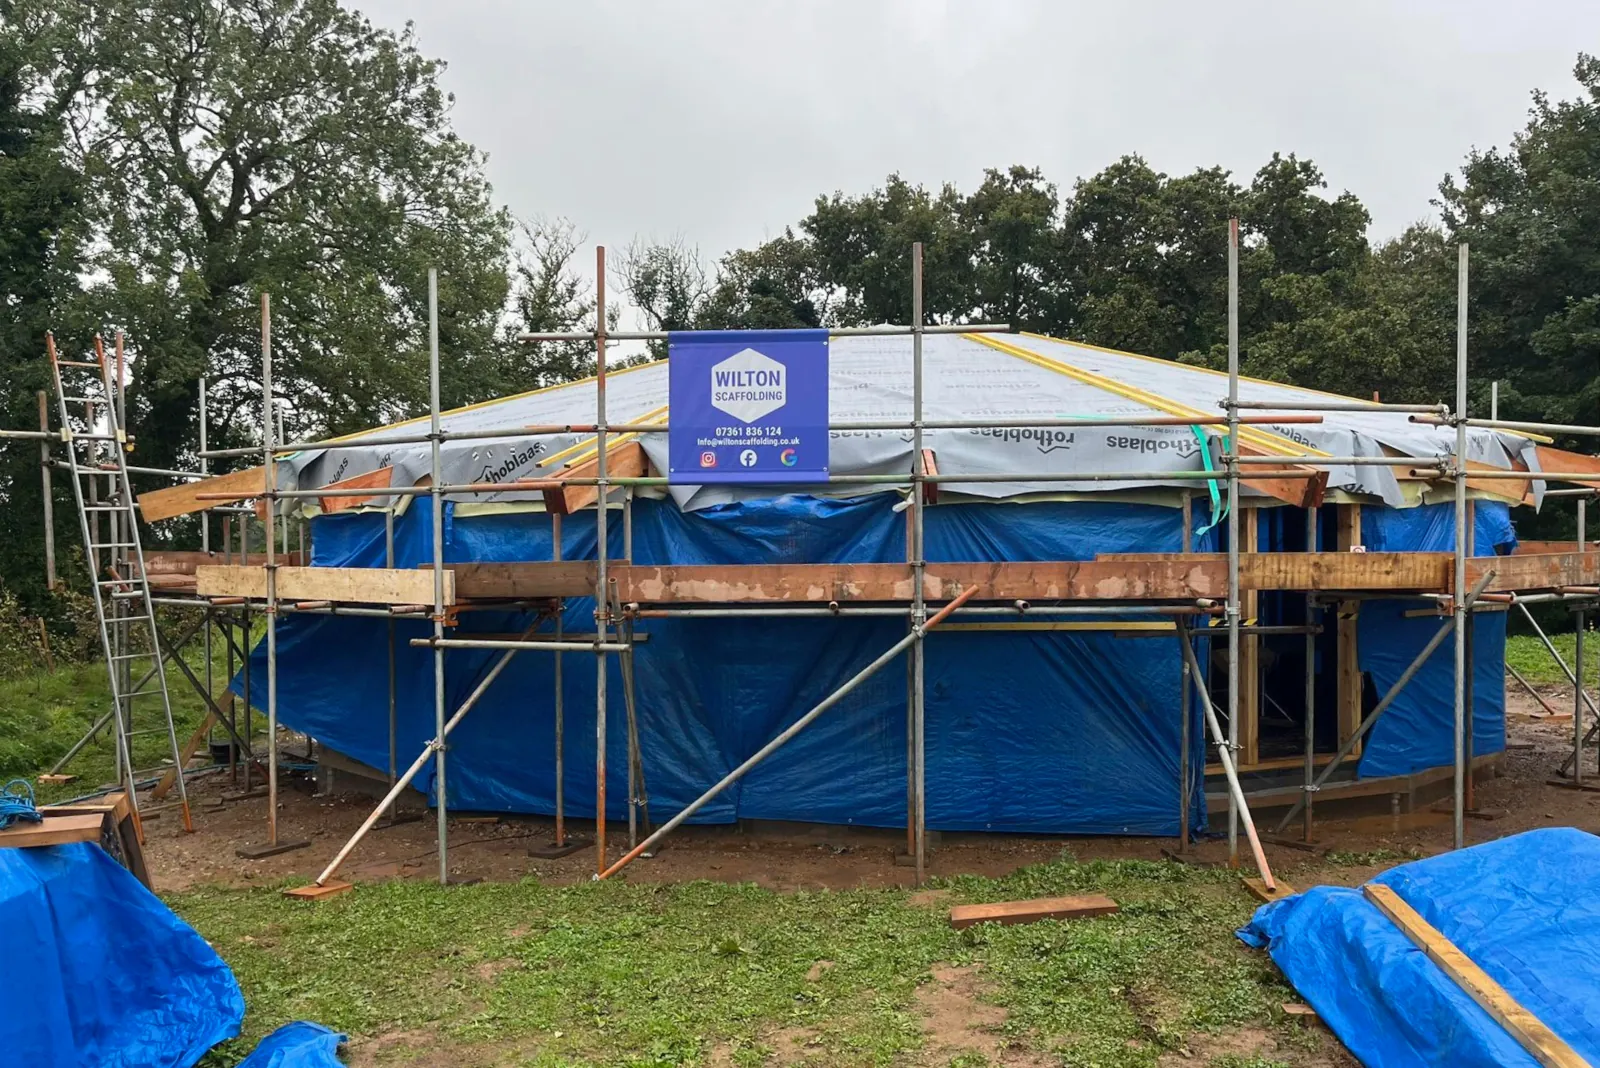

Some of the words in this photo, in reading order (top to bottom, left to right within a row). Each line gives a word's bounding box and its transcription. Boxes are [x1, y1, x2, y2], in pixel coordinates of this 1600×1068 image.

[715, 370, 781, 387] WILTON
[715, 391, 783, 401] SCAFFOLDING
[715, 427, 743, 436] 07361
[745, 427, 763, 436] 836
[765, 427, 782, 436] 124
[1106, 436, 1202, 453] othoblaas
[476, 442, 540, 492] thoblaas
